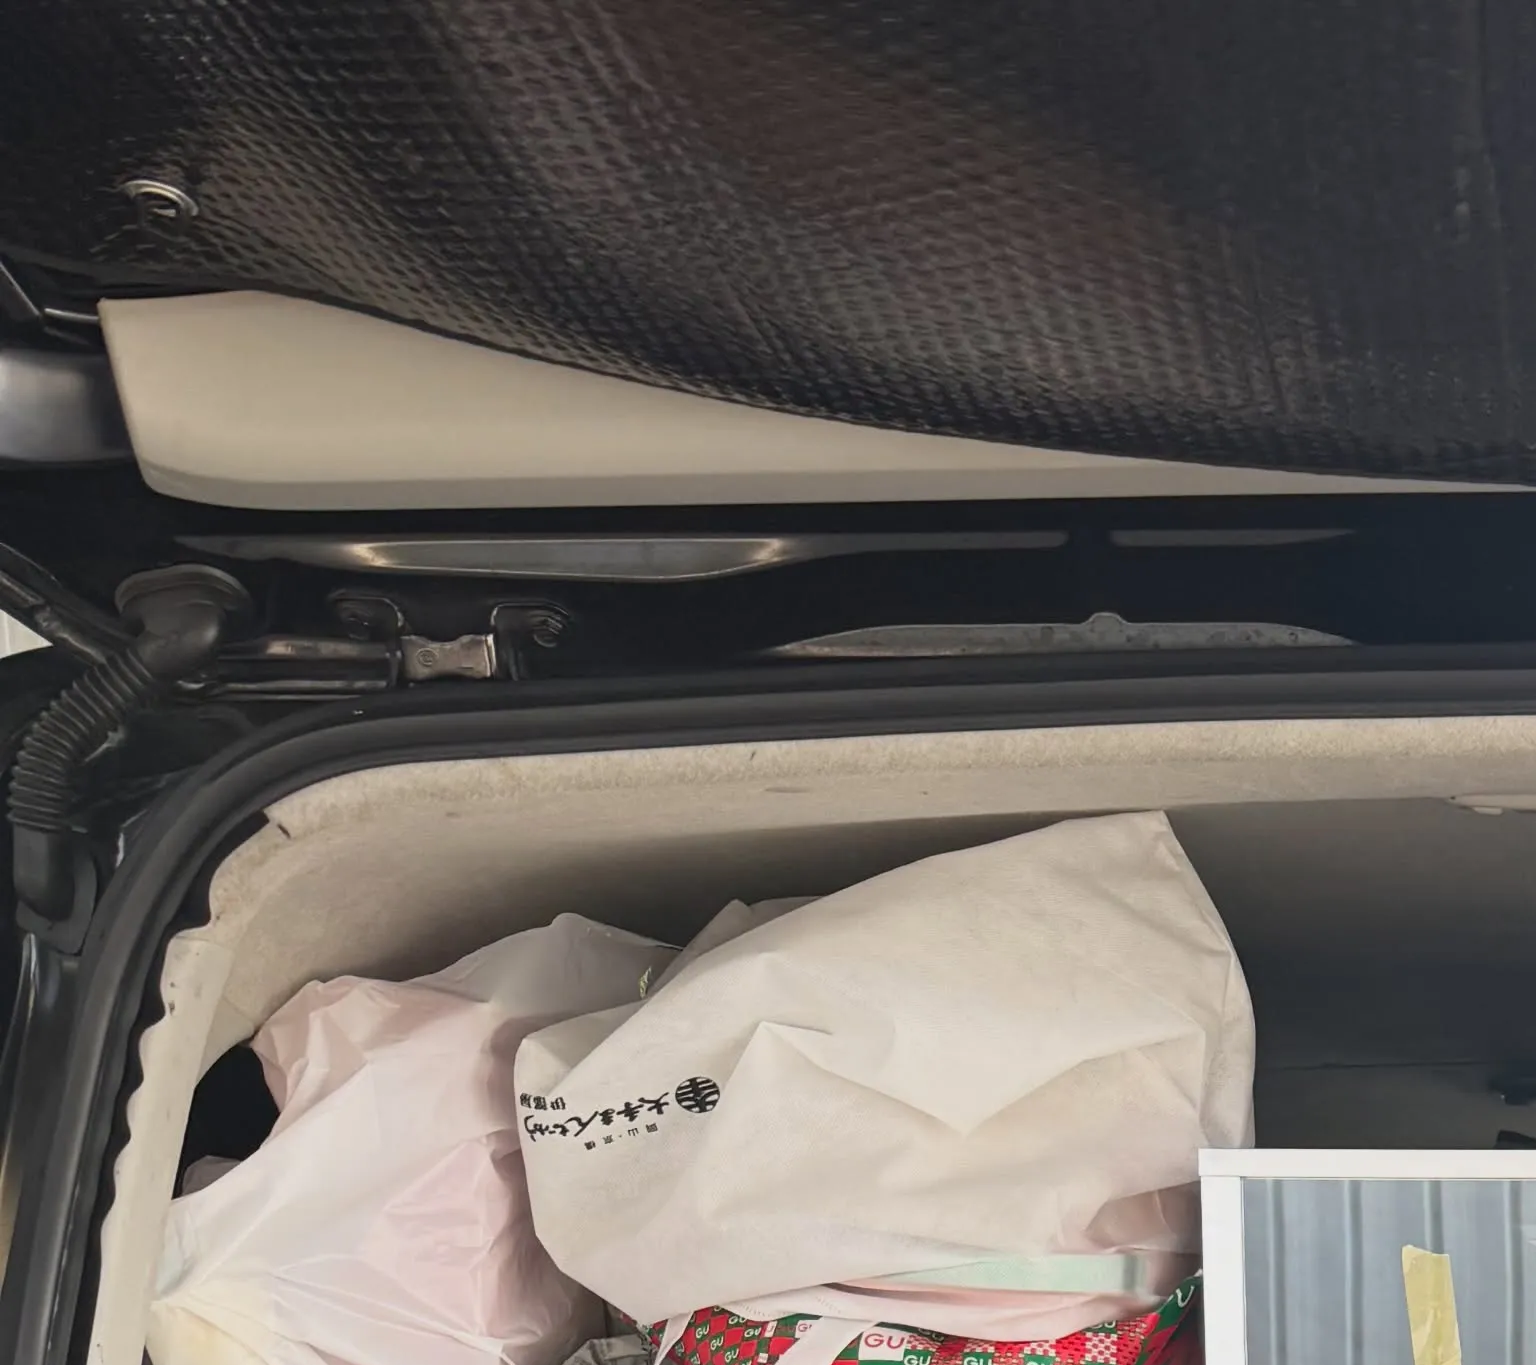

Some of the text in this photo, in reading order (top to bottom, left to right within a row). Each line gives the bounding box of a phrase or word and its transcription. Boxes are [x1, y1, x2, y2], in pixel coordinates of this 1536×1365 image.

[744, 1327, 762, 1337] GU
[710, 1336, 724, 1350] GU
[864, 1333, 905, 1350] GU
[724, 1348, 740, 1362] GU
